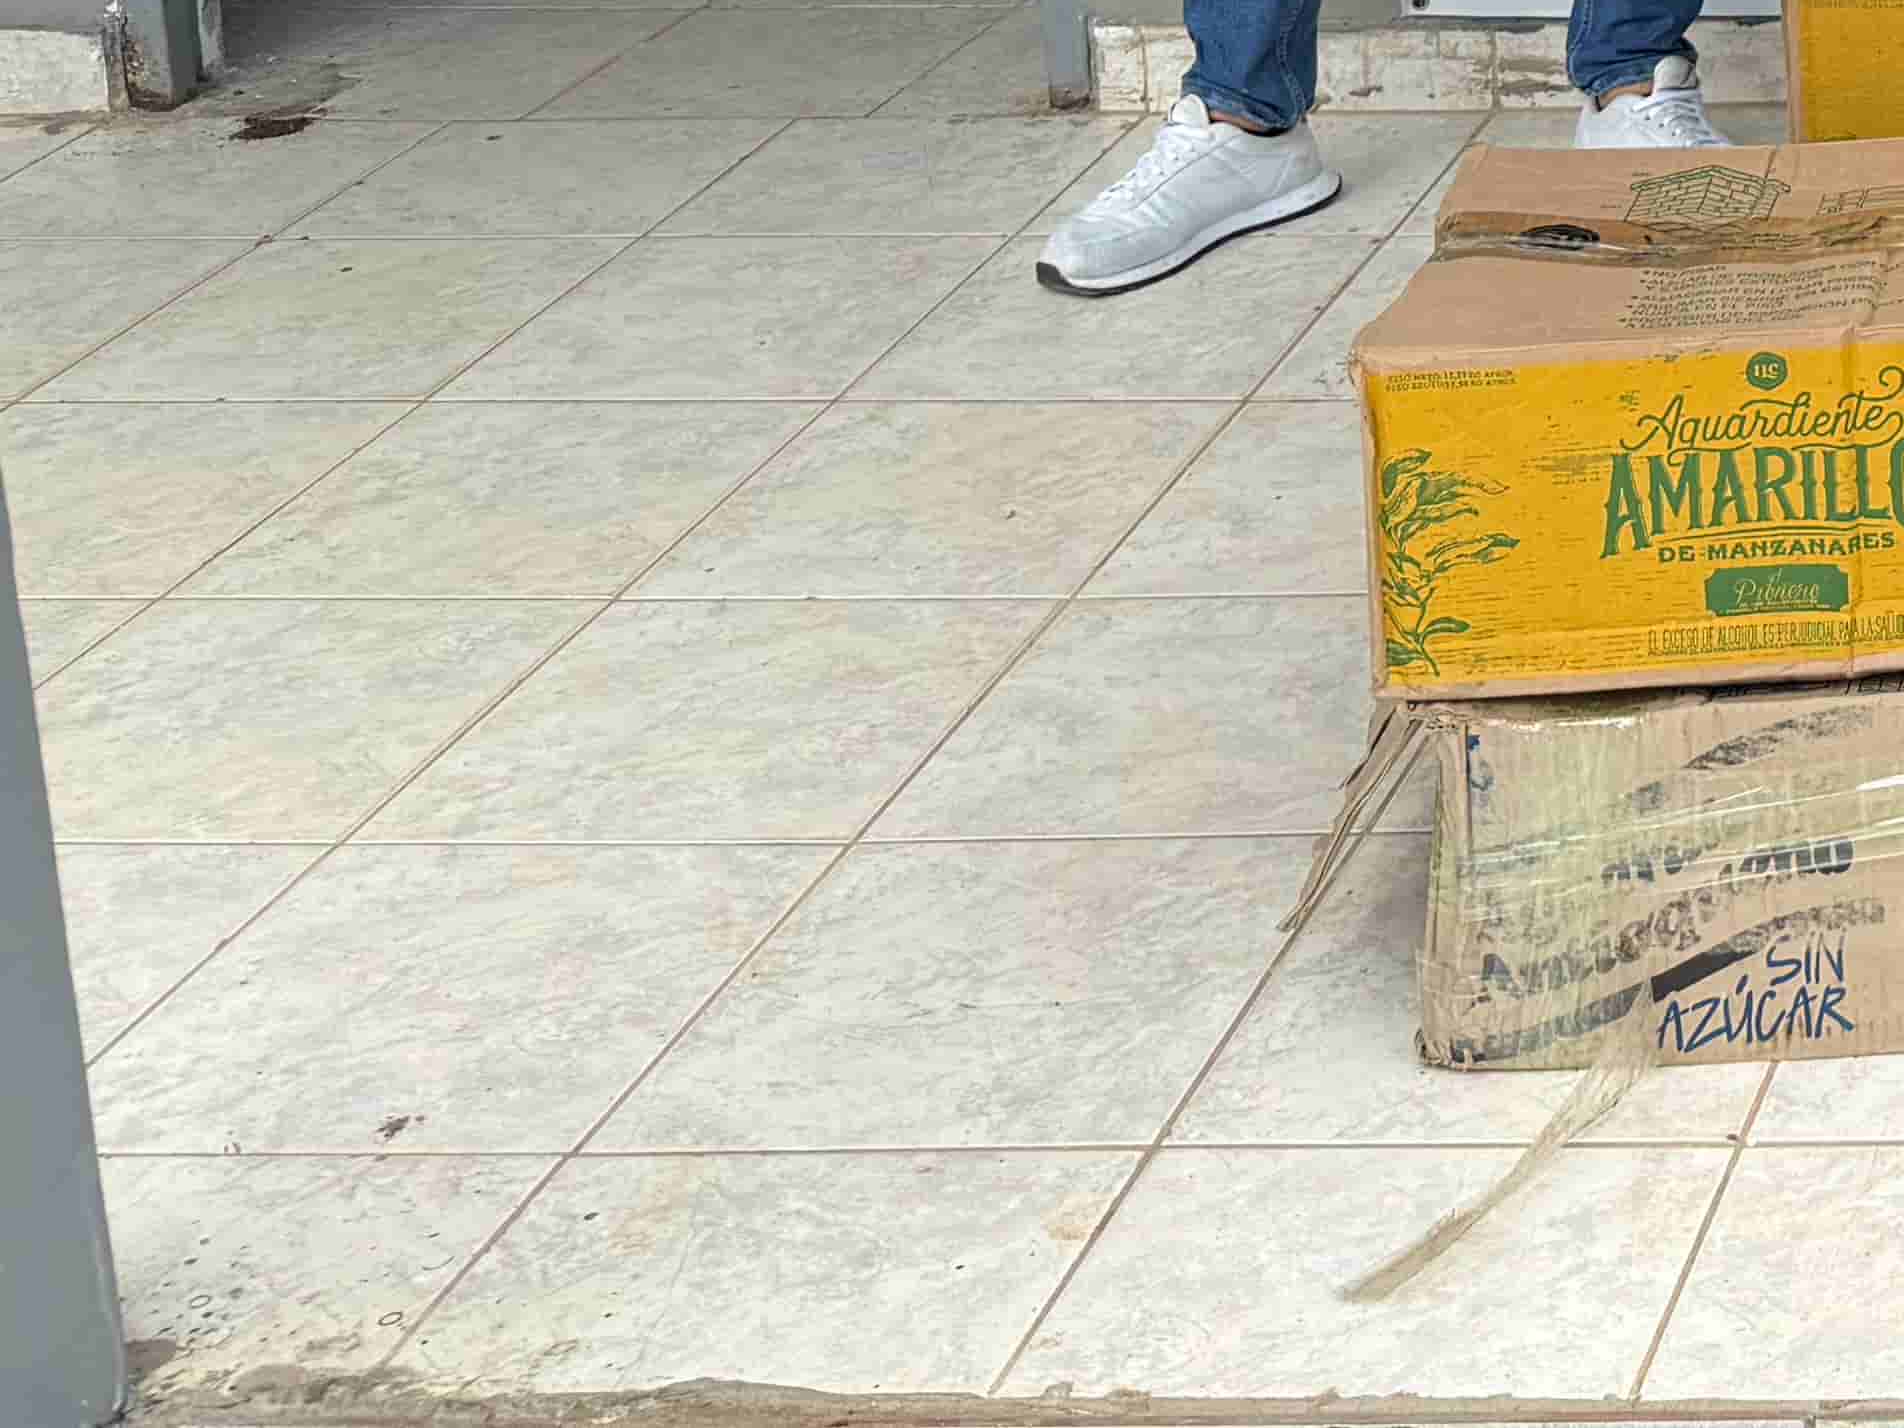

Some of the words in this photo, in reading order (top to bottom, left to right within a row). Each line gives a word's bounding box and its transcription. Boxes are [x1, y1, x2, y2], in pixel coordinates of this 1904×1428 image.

[1658, 544, 1697, 564] DE
[1704, 530, 1897, 562] MANZANARES
[1765, 934, 1847, 989] SIN
[1655, 974, 1856, 1054] AZÚCAR
